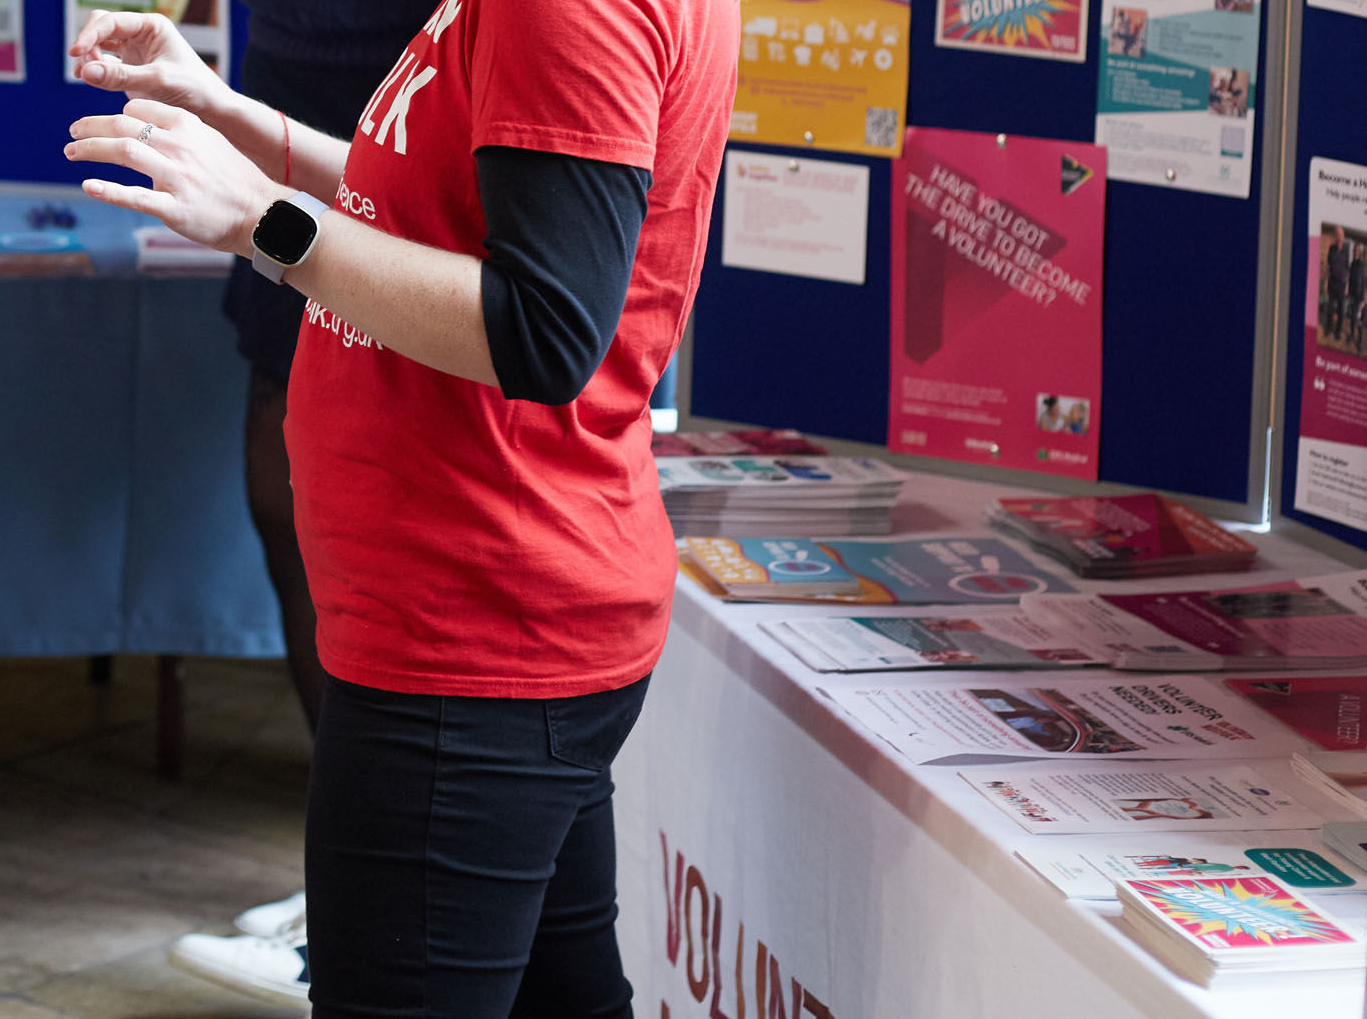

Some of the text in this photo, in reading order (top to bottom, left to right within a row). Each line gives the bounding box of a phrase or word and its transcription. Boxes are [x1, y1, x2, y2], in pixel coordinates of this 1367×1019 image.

[904, 172, 937, 211] THE
[940, 191, 992, 242] DRIVE
[994, 228, 1015, 257] TO
[1015, 245, 1091, 306] BECOME
[930, 164, 1050, 252] HAVE YOU GOT
[931, 217, 1058, 308] A VOLUNTEER?
[1130, 684, 1185, 716] DRIVERS
[1157, 683, 1226, 722] VOLUNTEER
